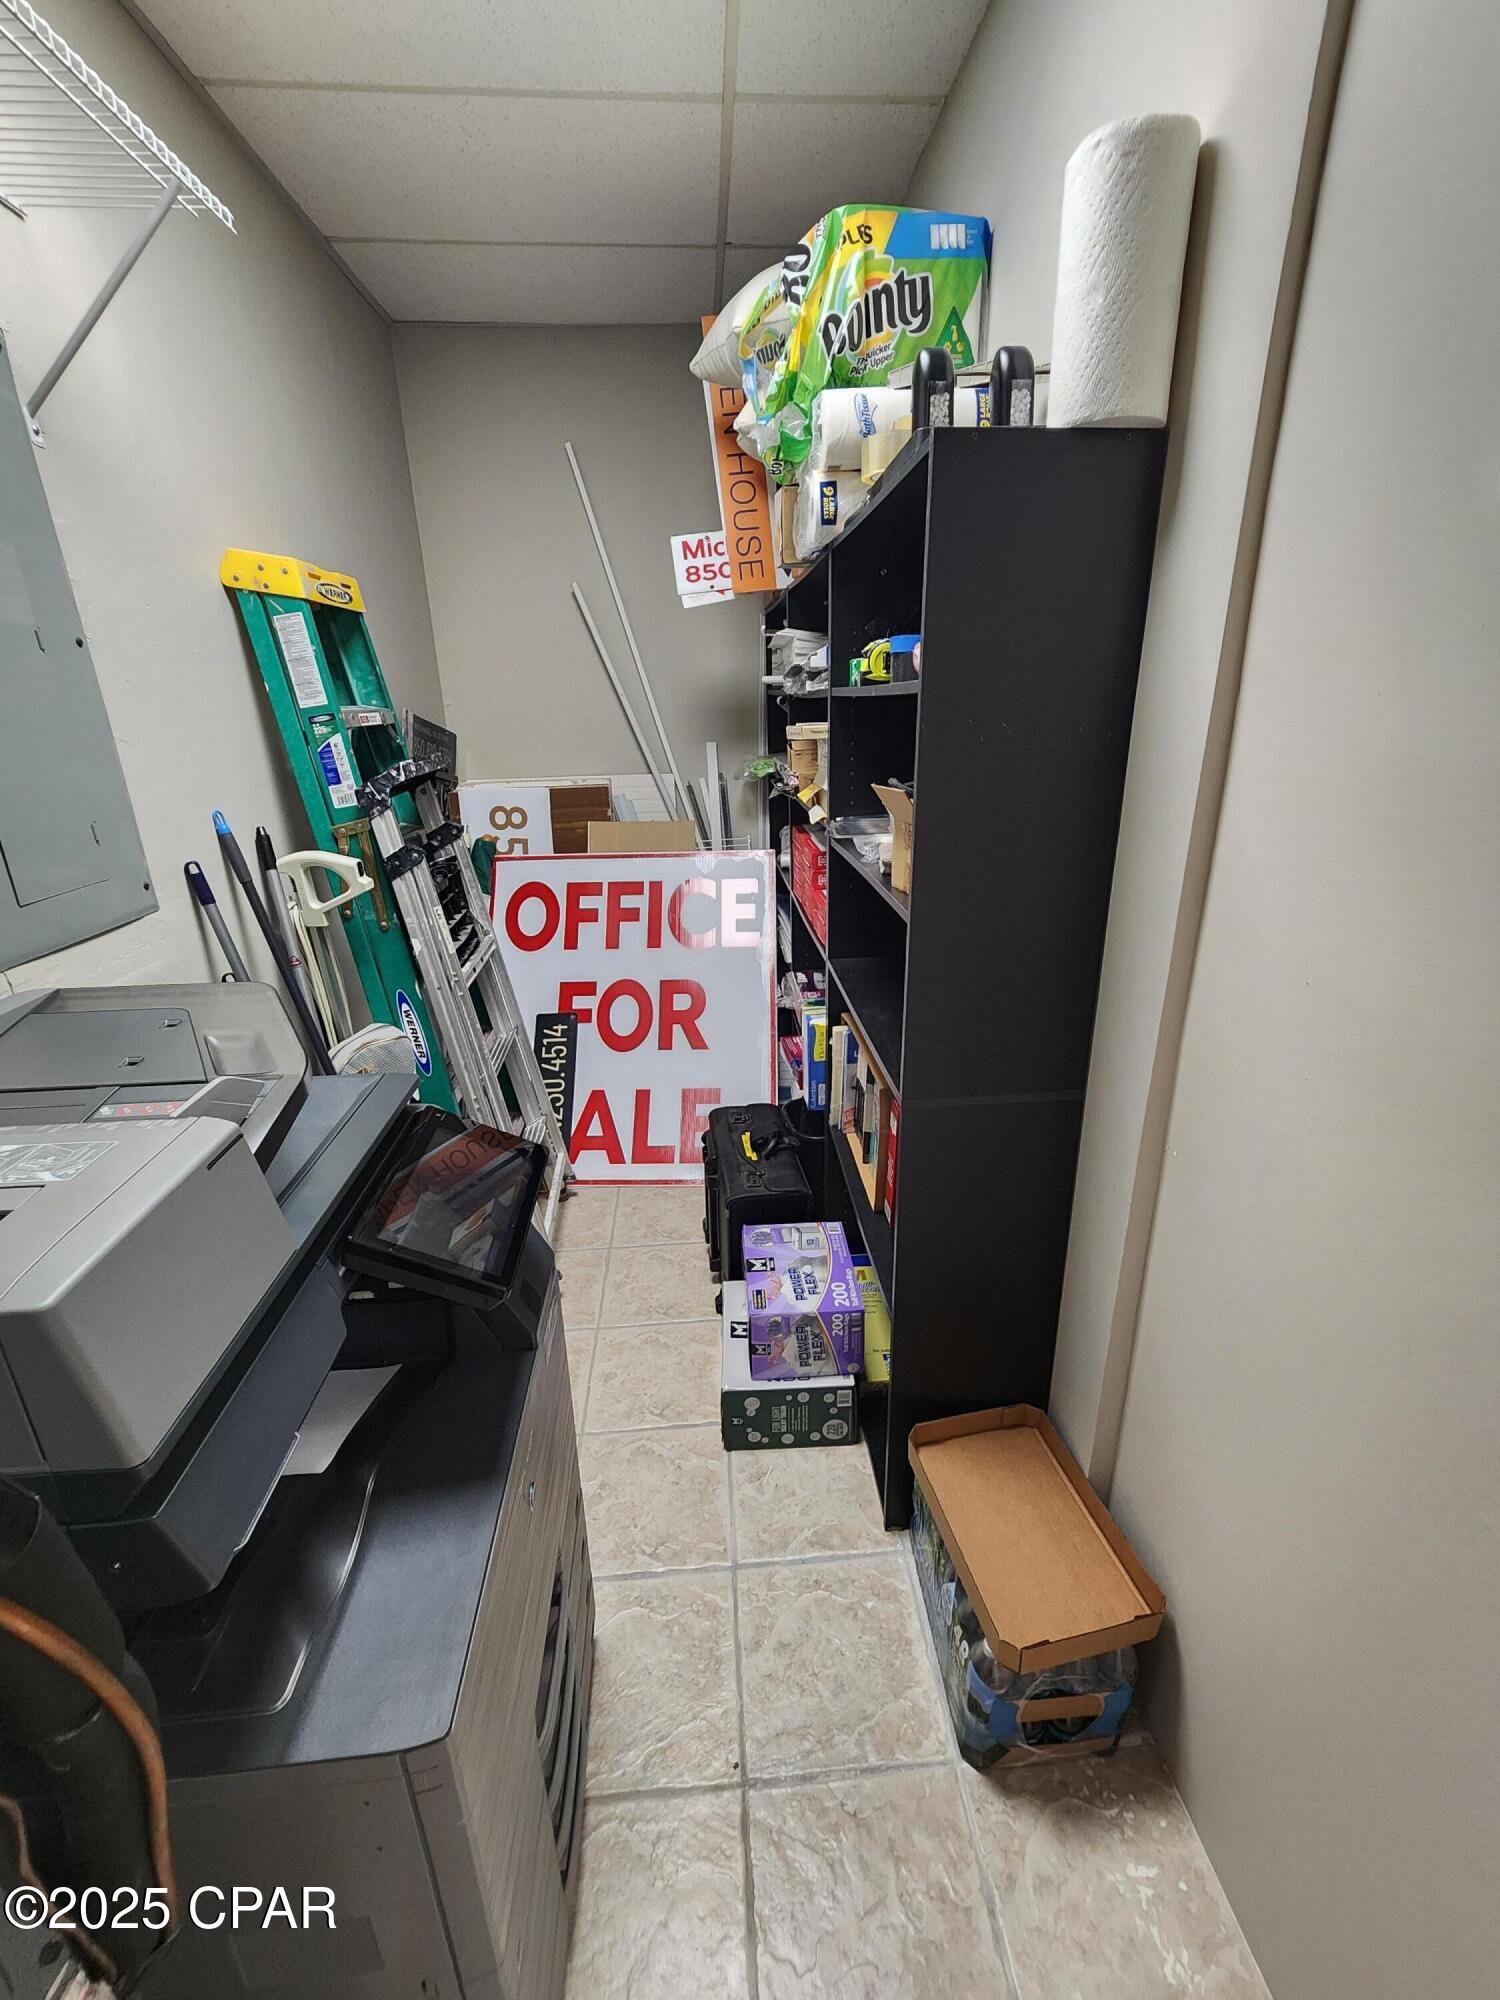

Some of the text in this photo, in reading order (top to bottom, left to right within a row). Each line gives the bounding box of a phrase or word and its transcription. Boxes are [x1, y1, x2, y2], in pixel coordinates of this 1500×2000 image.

[726, 452, 765, 581] HOUSE
[504, 876, 761, 952] OFFICE
[403, 1009, 426, 1059] WERNER
[558, 978, 709, 1052] FOR
[570, 1087, 722, 1165] ALE
[787, 1266, 808, 1301] POWER
[804, 1271, 820, 1296] FLEX
[831, 1282, 850, 1307] 200
[795, 1324, 812, 1367] POWER
[809, 1330, 827, 1362] FLEX
[831, 1313, 844, 1337] 200
